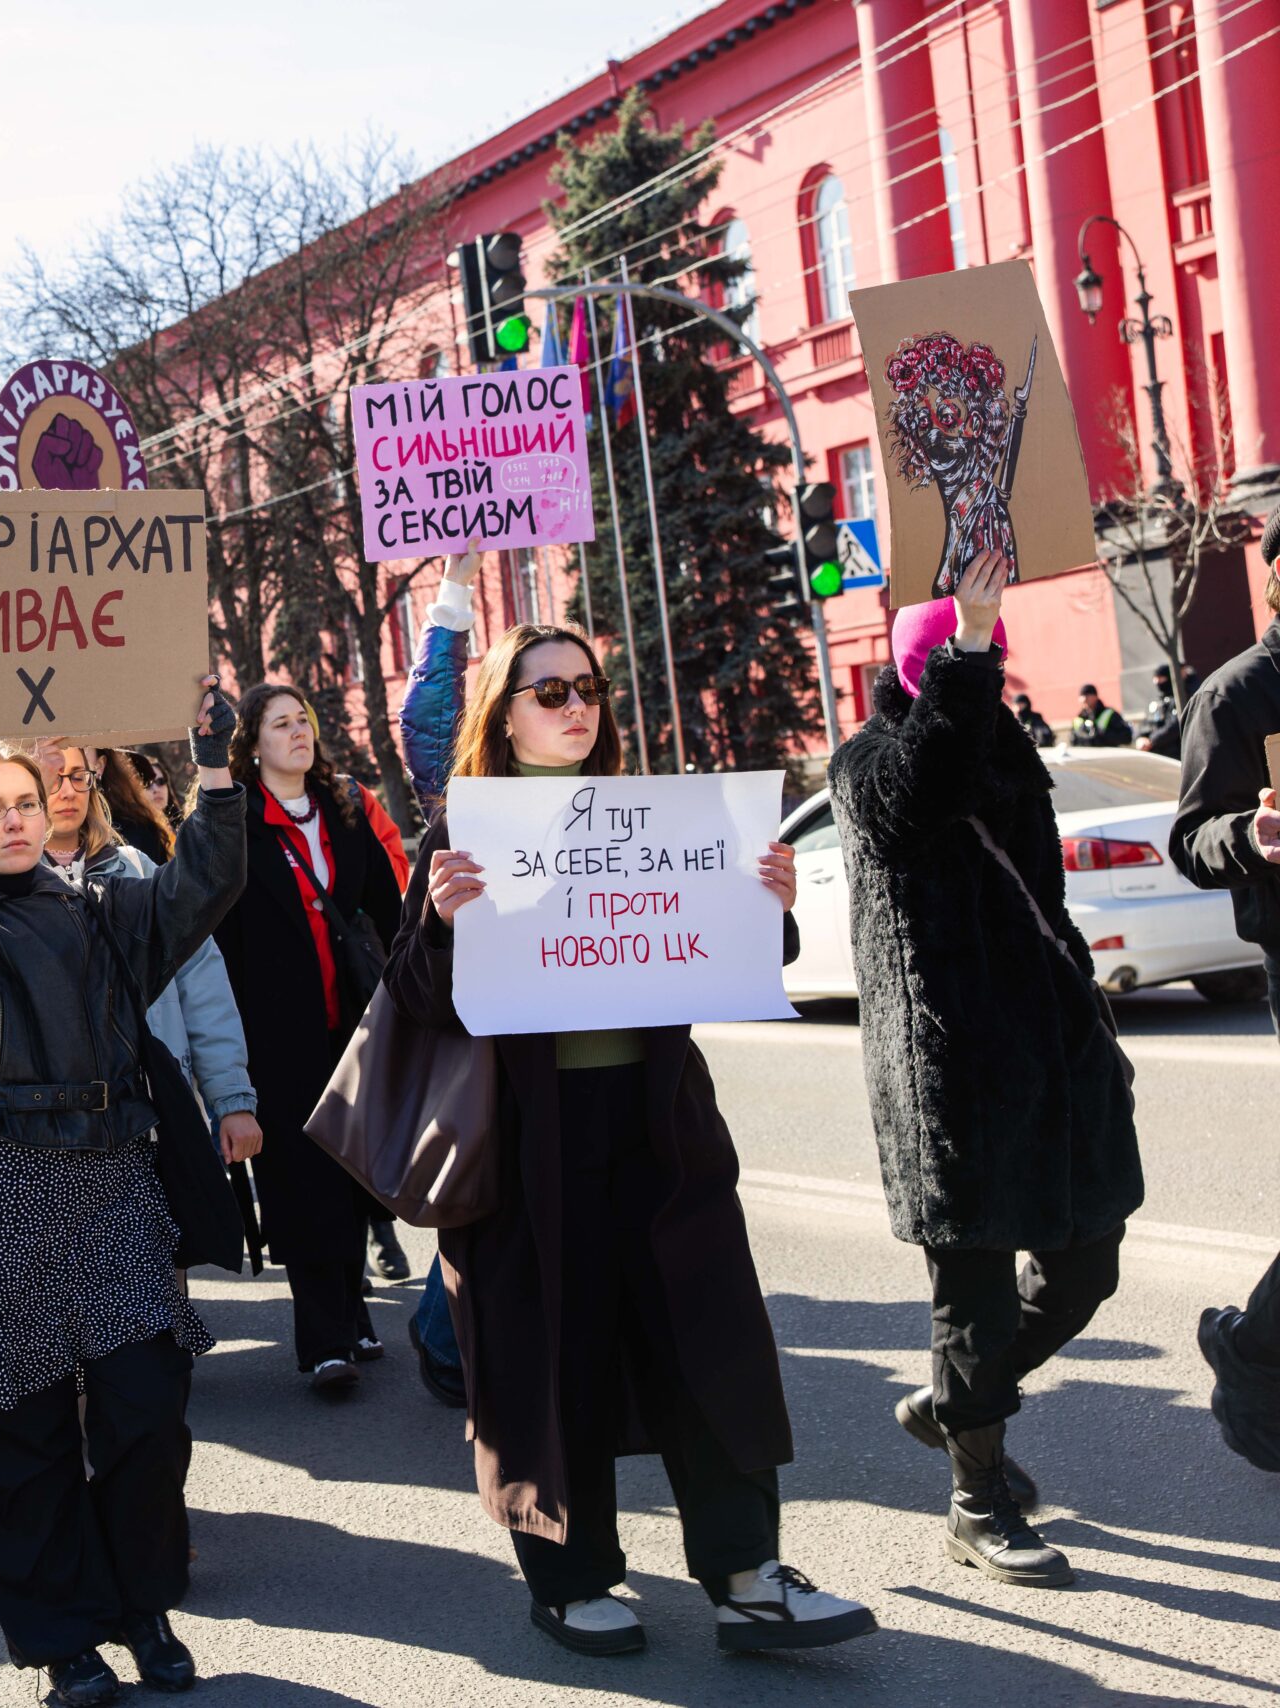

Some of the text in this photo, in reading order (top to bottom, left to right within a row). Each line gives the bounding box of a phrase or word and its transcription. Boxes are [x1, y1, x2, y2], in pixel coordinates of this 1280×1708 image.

[462, 374, 571, 417] ГОЛОС
[375, 476, 414, 508] ЗА
[378, 495, 537, 547] СЕКСИЗМ
[565, 787, 596, 831] Я
[511, 840, 725, 878] ЗА СЕБЕ, ЗА НЕЇ
[541, 932, 709, 967] НОВОГО ЦК
